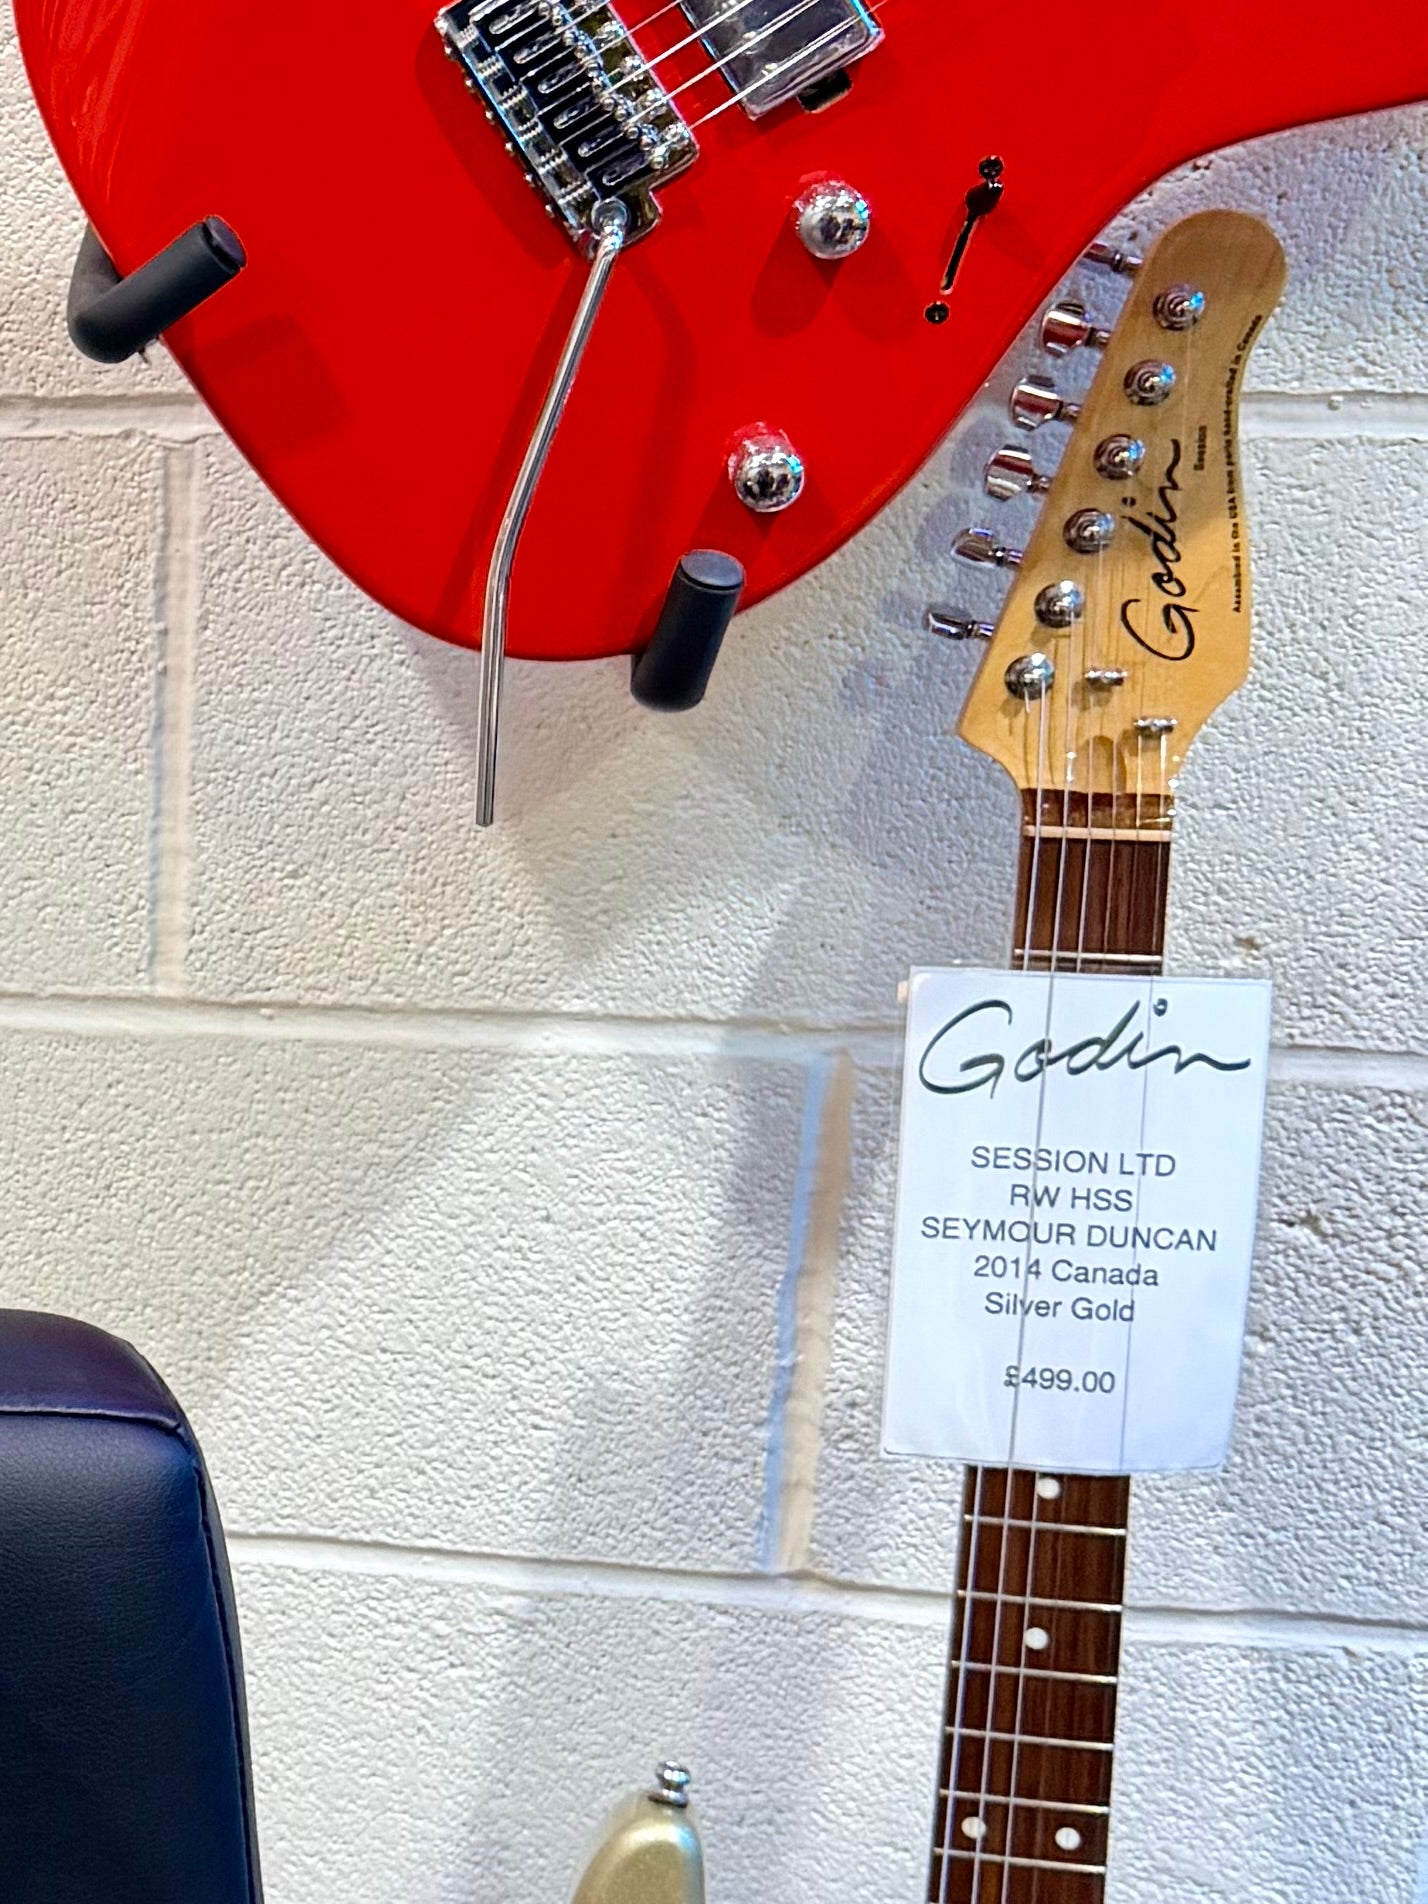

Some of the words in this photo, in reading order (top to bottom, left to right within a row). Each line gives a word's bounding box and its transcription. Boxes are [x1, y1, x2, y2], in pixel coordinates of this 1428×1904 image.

[1121, 438, 1199, 662] Godin
[919, 998, 1252, 1099] Godin
[971, 1146, 1109, 1175] SESSION
[1120, 1153, 1176, 1177] LTD
[1010, 1185, 1061, 1208] RW
[1072, 1187, 1133, 1212] HSS
[921, 1217, 1076, 1246] SEYMOUR
[1087, 1225, 1217, 1252] DUNCAN
[974, 1256, 1041, 1280] 2014
[1052, 1260, 1159, 1287] Canada
[985, 1292, 1062, 1319] Silver
[1072, 1297, 1135, 1322] Gold
[1005, 1366, 1115, 1393] £499.00
